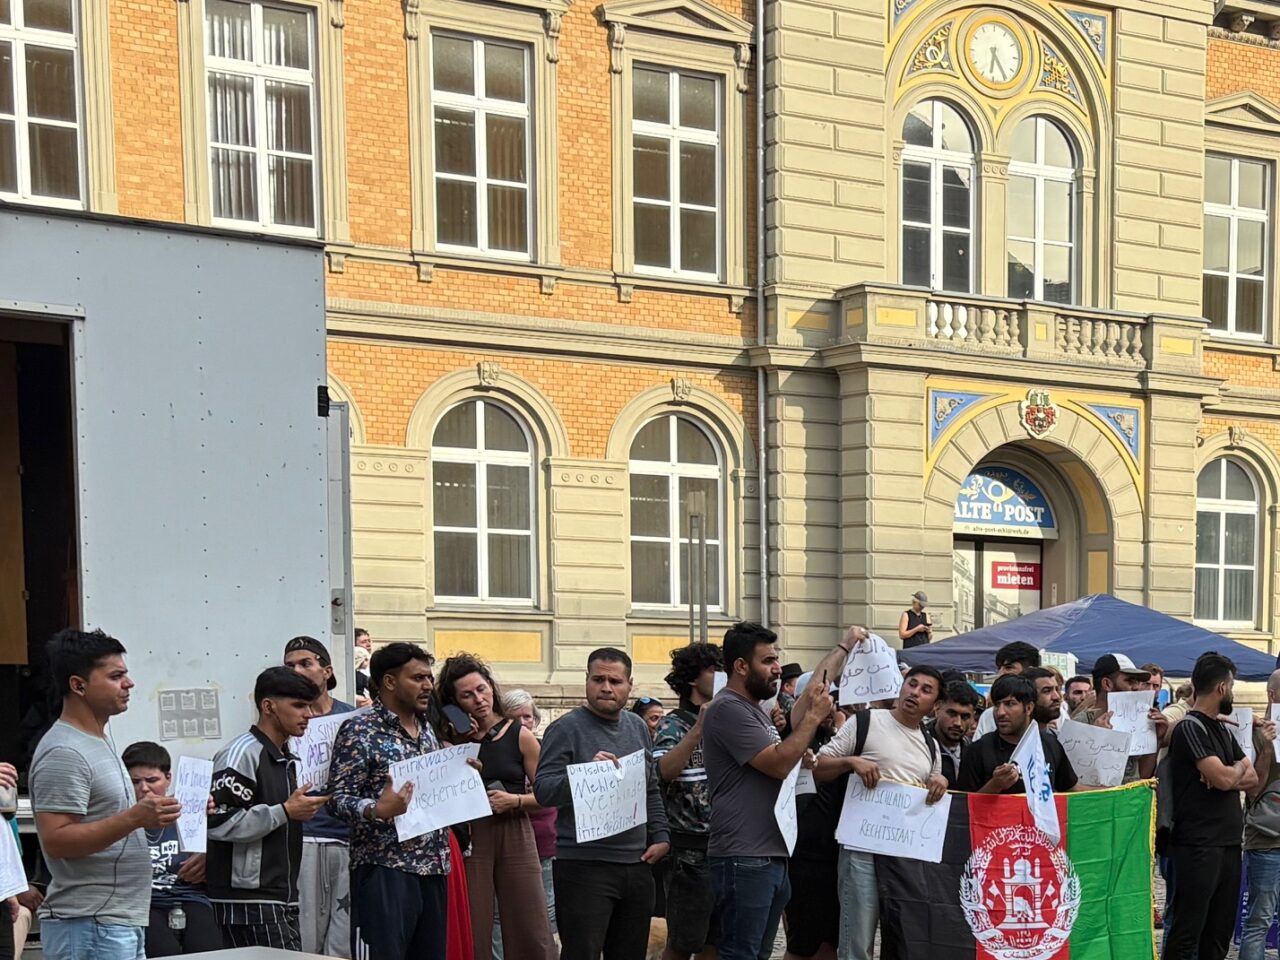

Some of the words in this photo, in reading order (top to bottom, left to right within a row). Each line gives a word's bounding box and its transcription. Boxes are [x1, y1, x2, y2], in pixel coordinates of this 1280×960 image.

[953, 501, 991, 520] ALTE
[1004, 506, 1044, 523] POST
[997, 573, 1034, 585] mieten
